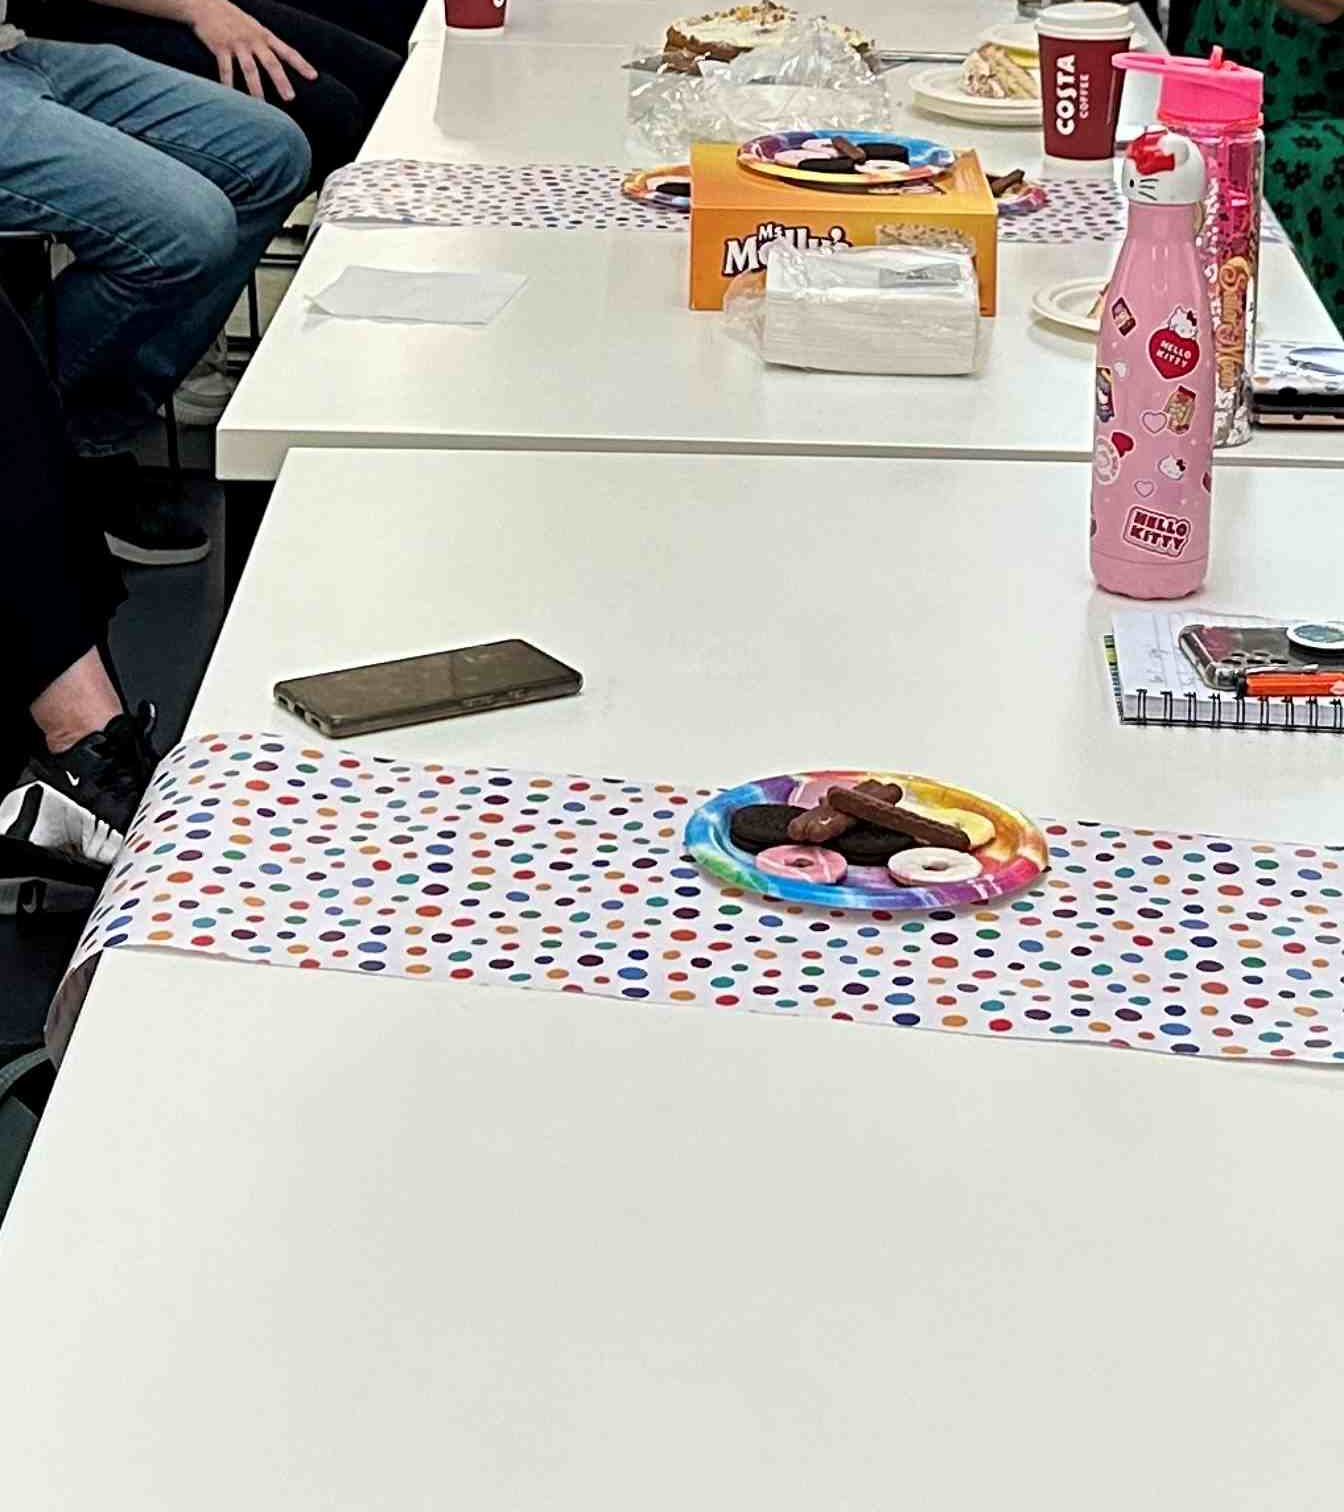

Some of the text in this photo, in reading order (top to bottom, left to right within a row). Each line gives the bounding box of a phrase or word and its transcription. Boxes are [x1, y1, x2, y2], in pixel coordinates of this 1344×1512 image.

[1056, 54, 1077, 136] COSTA
[1079, 74, 1090, 119] COFFEE
[758, 222, 784, 241] Ms
[1156, 348, 1188, 368] KITTY
[1159, 339, 1192, 359] HELLO
[1129, 524, 1185, 550] KITTY
[1133, 511, 1188, 537] HELLO
